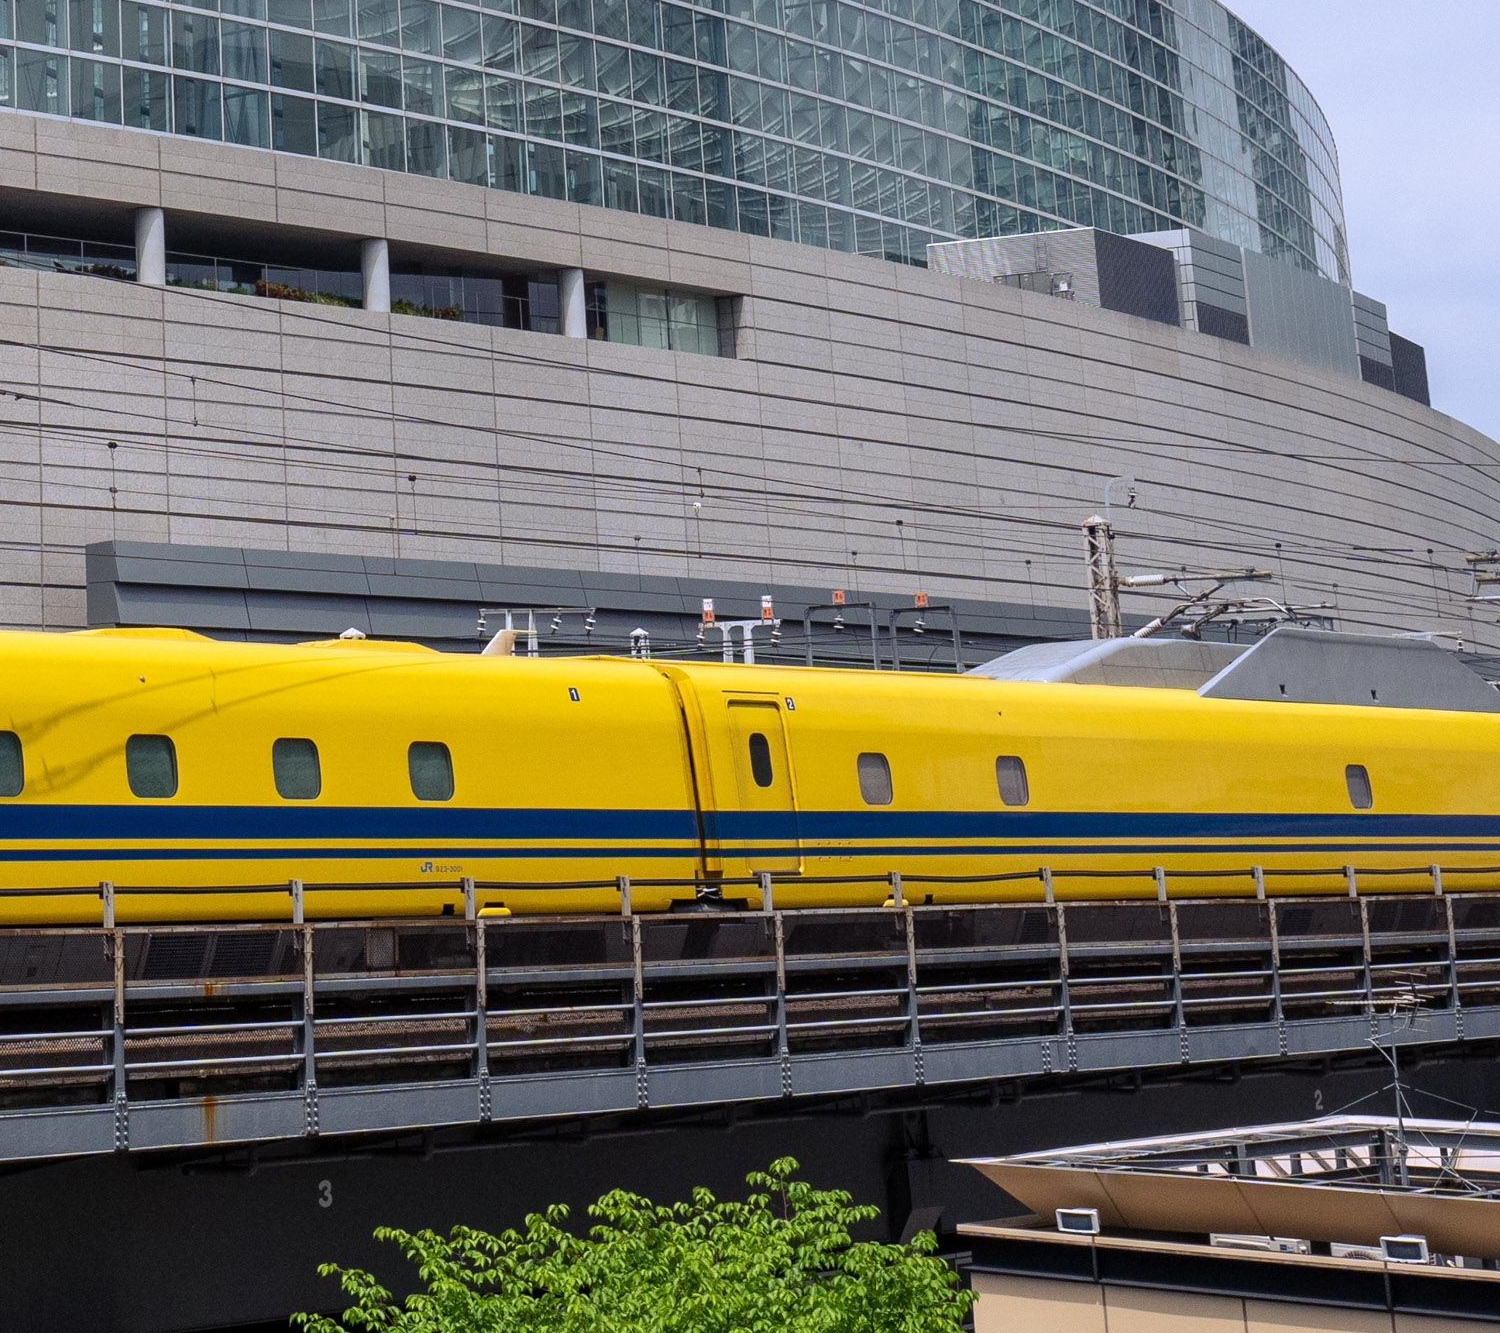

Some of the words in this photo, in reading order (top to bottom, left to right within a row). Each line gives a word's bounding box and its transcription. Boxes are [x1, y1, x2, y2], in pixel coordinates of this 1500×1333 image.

[420, 861, 433, 873] JR
[1314, 1089, 1324, 1110] 2
[318, 1179, 333, 1208] 3
